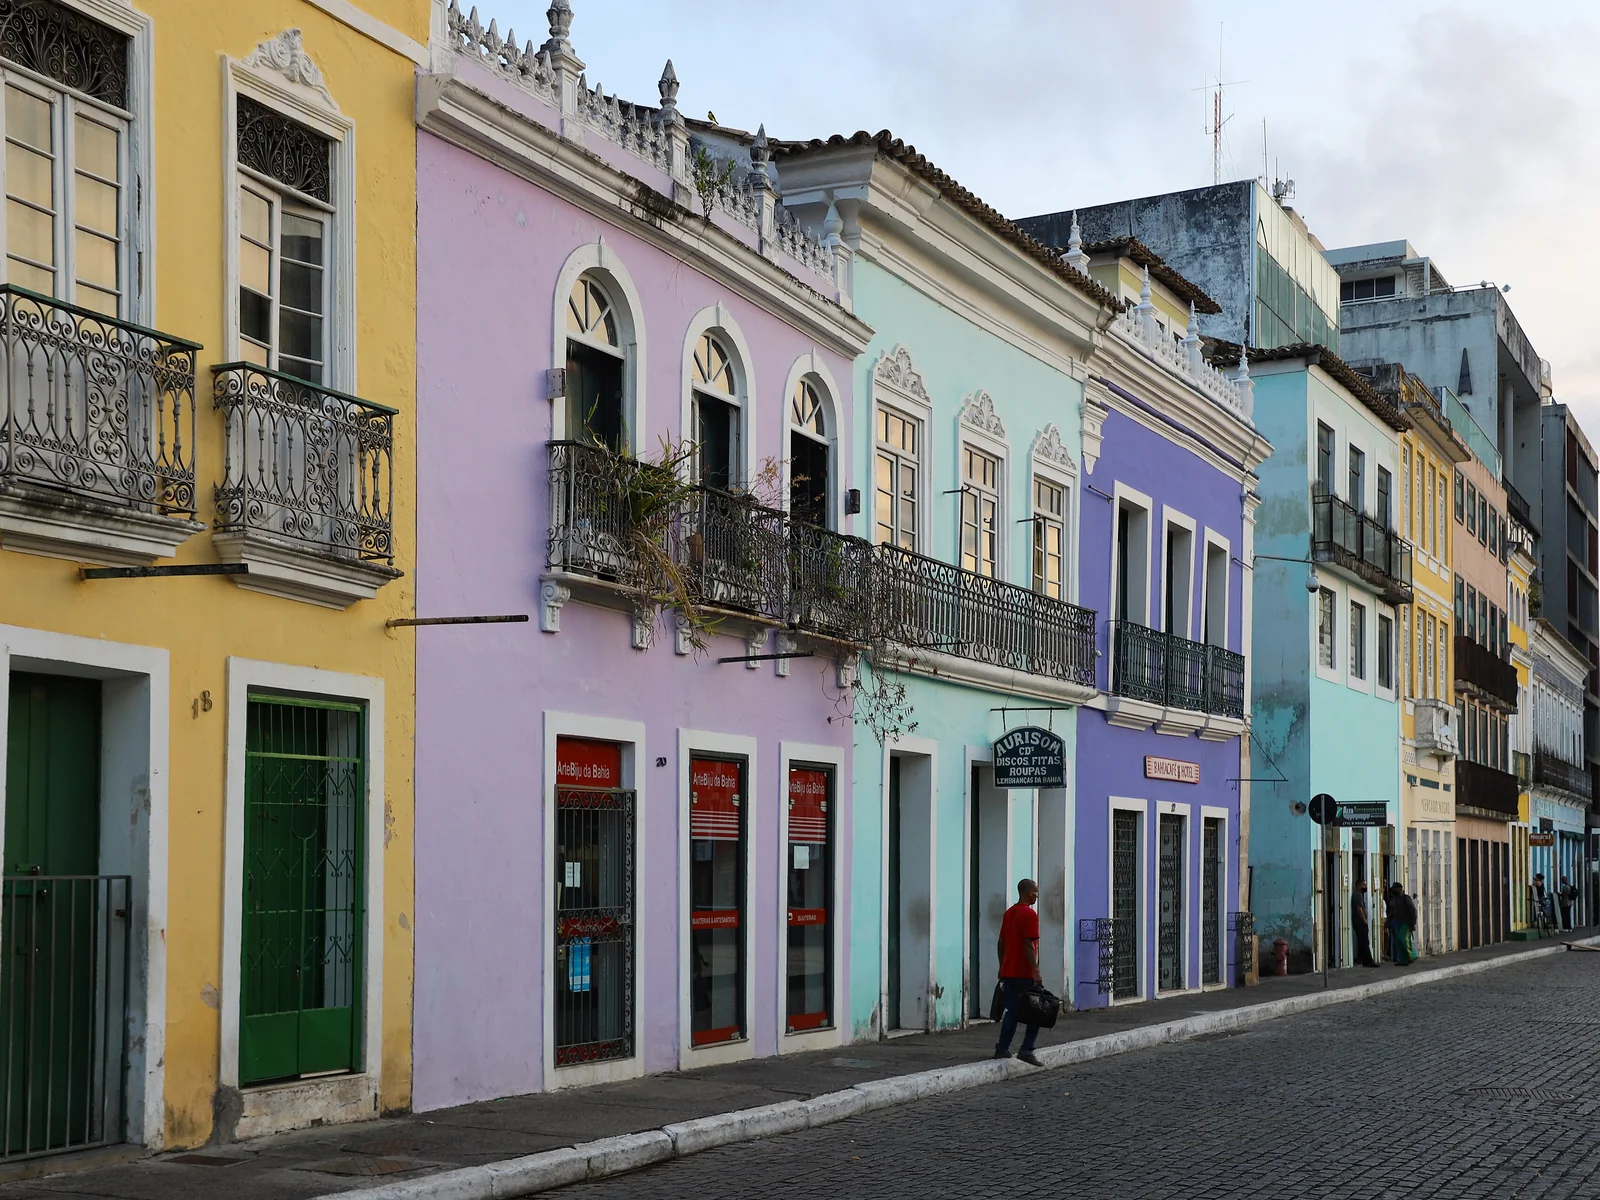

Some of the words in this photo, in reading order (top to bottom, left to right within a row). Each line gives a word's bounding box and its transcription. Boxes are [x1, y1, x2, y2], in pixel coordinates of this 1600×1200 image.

[192, 689, 213, 720] 18
[996, 731, 1061, 757] AURISOM
[557, 761, 582, 781] ArteBiju
[583, 766, 592, 778] da
[592, 764, 610, 779] Bahia
[1009, 766, 1047, 777] ROUPAS
[1180, 765, 1194, 779] HOTEL
[693, 772, 713, 789] ArteBiju
[713, 774, 721, 787] da
[721, 774, 736, 788] Bahia
[996, 777, 1034, 785] LEMBRANÇAS
[1042, 776, 1062, 784] BAHIA
[805, 782, 812, 794] da
[812, 782, 825, 795] Bahia
